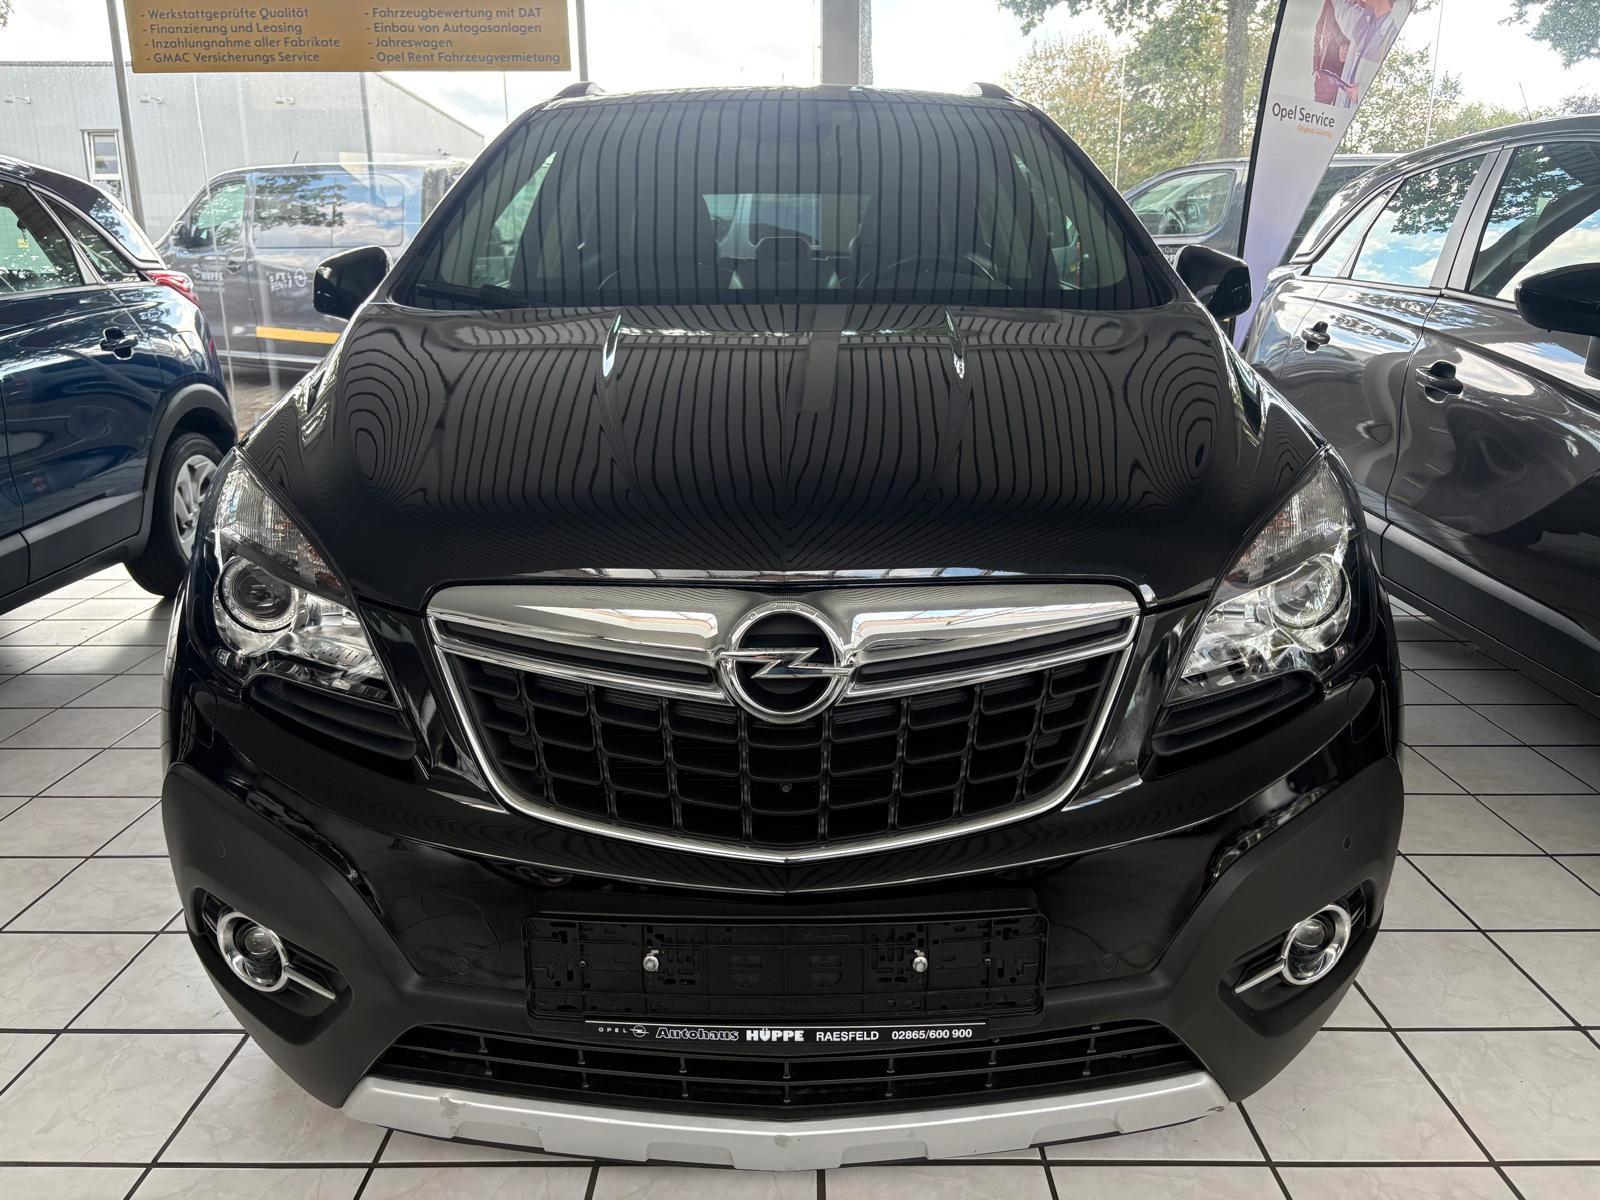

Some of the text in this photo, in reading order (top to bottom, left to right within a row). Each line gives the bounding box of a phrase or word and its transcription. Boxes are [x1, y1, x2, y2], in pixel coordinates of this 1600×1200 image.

[148, 8, 256, 21] Werkstattgeprüfte
[259, 7, 308, 20] Qualität
[372, 8, 493, 21] Fahrzeugbewertung
[496, 8, 515, 18] mit
[519, 8, 542, 18] DAT
[150, 23, 228, 35] Finanzierung
[230, 23, 253, 33] und
[256, 23, 303, 35] Leasing
[374, 23, 415, 33] Einbau
[418, 25, 439, 33] von
[443, 23, 542, 36] Autogasanlagen
[152, 38, 251, 50] Inzahlungnahme
[254, 37, 280, 48] aller
[284, 37, 340, 48] Fabrikate
[375, 37, 453, 50] Jahreswagen
[154, 53, 191, 63] GMAC
[193, 52, 276, 64] Versicherungs
[278, 52, 320, 62] Service
[376, 52, 405, 64] Opel
[408, 52, 435, 62] Rent
[438, 52, 560, 64] Fahrzeugvermietung
[1272, 102, 1335, 128] Opel Service
[655, 1027, 739, 1041] Autohaus
[746, 1027, 804, 1042] HÜPPE
[816, 1031, 879, 1041] RAESFELD
[891, 1029, 950, 1041] 02865/600
[952, 1028, 973, 1038] 900
